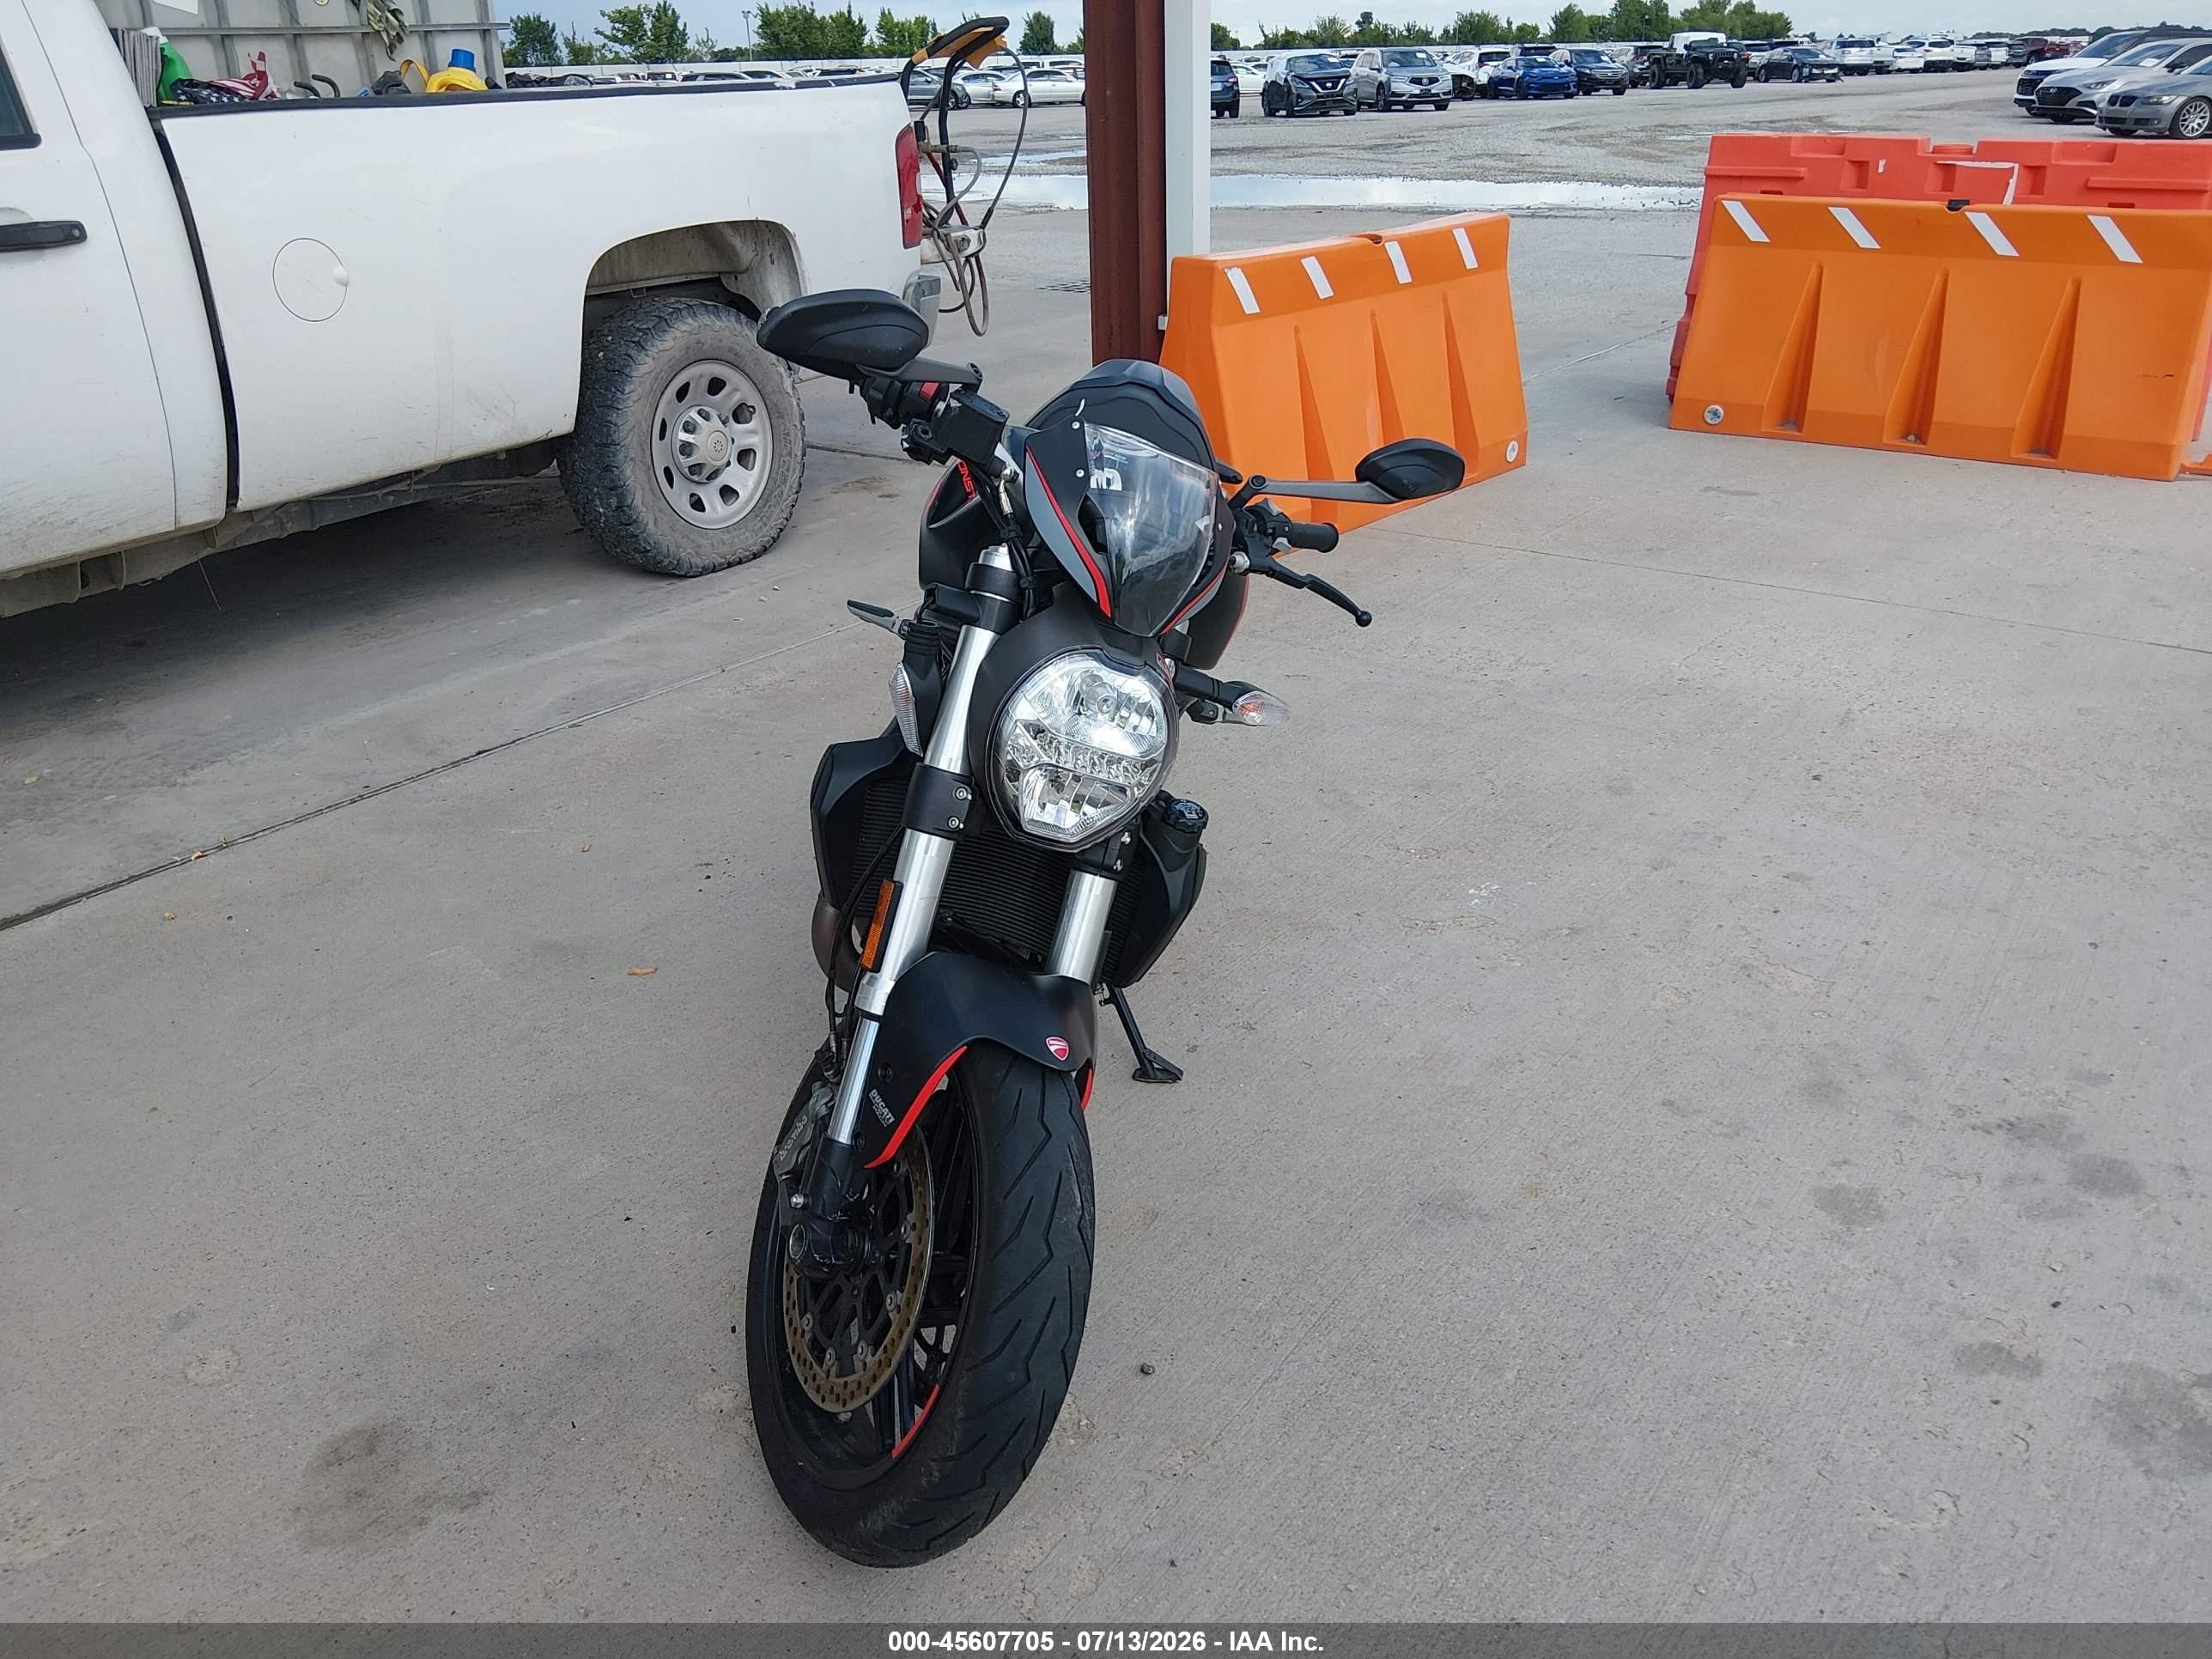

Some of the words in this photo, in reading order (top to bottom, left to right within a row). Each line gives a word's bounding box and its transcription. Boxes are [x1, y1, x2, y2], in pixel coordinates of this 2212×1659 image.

[957, 460, 975, 499] ONST
[871, 1089, 895, 1125] DUCATI
[779, 1115, 807, 1161] brembo
